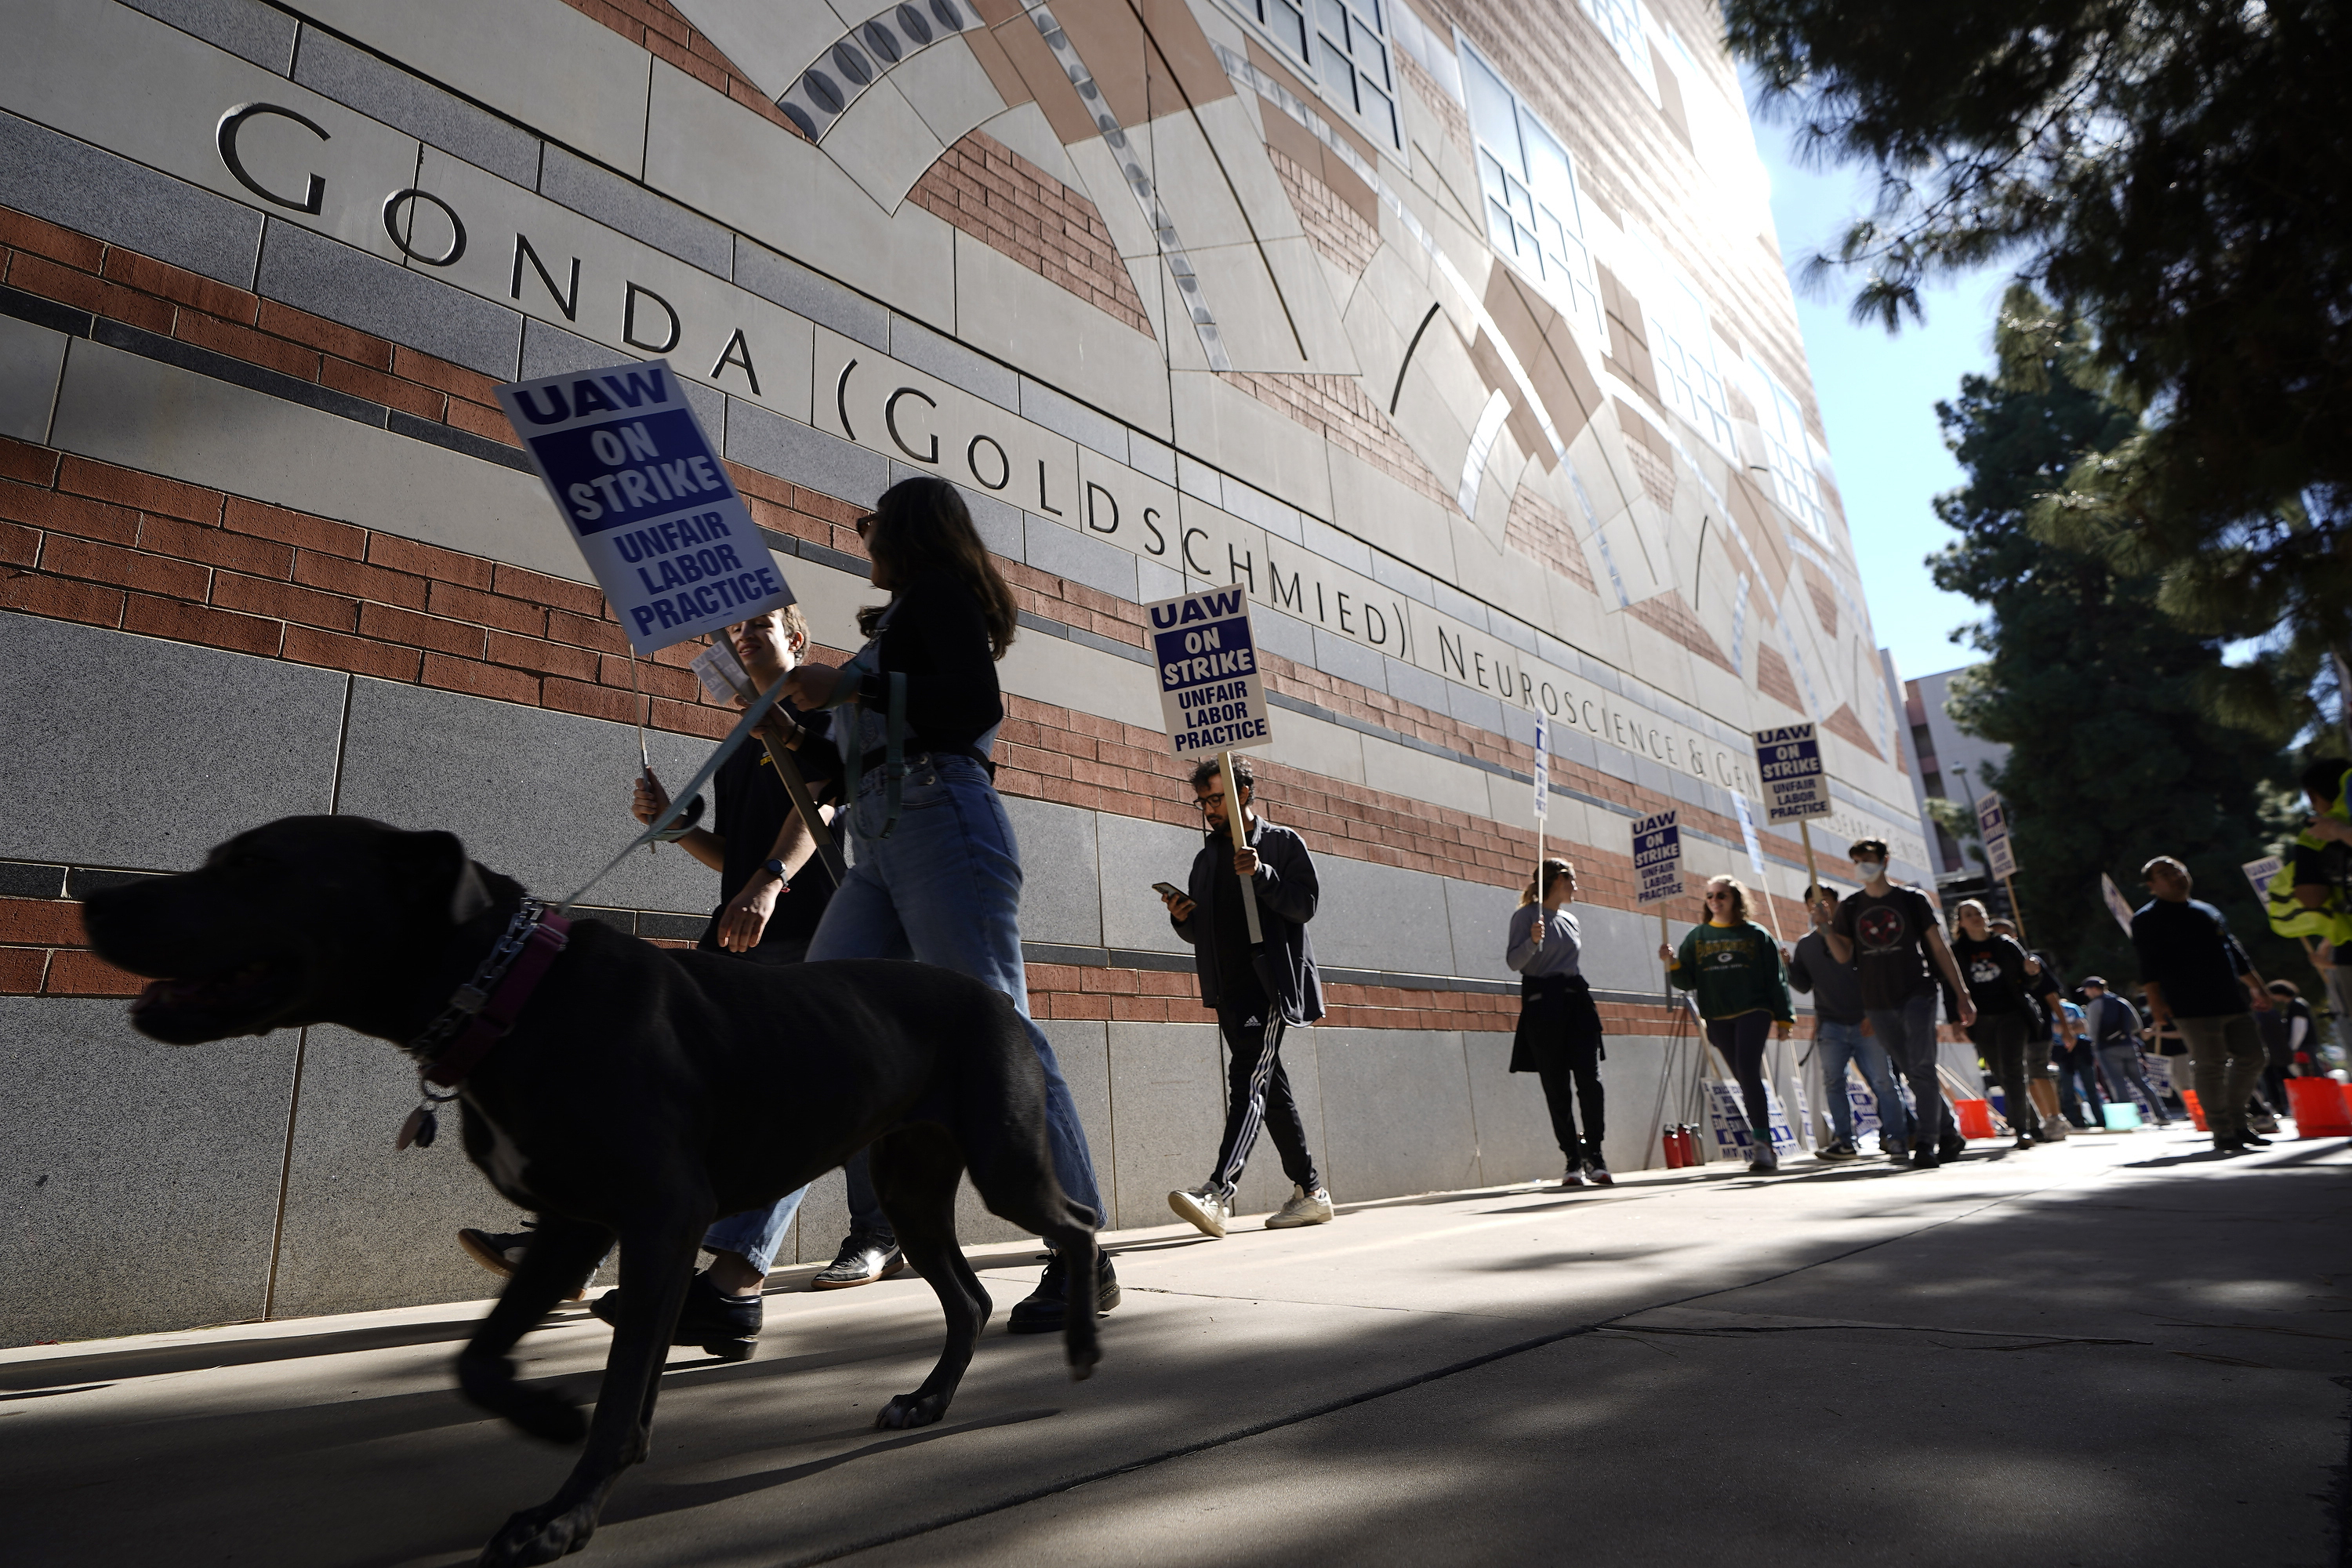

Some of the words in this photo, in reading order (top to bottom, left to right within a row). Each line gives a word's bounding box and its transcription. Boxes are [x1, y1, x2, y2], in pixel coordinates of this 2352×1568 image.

[511, 368, 668, 425] UAW
[216, 102, 761, 396] GONDA
[837, 358, 1405, 659] (GOLDSCHMIED)
[1438, 626, 1678, 765] NEUROSCIENCE
[1688, 739, 1708, 778] &
[590, 421, 659, 466] ON
[568, 455, 722, 521] STRIKE
[612, 511, 731, 563] UNFAIR
[637, 544, 743, 595] LABOR
[630, 568, 781, 637] PRACTICE
[1151, 590, 1242, 629] UAW
[1185, 627, 1221, 654] ON
[1164, 648, 1253, 685] STRIKE
[1178, 681, 1247, 709] UNFAIR
[1185, 702, 1248, 728] LABOR
[1174, 718, 1267, 752] PRACTICE
[1757, 724, 1812, 744] UAW
[1776, 744, 1800, 760] ON
[1762, 757, 1819, 779] STRIKE
[1773, 779, 1816, 793] UNFAIR
[1777, 790, 1816, 805] LABOR
[1770, 800, 1828, 818] PRACTICE
[1633, 810, 1675, 835] UAW
[1646, 832, 1664, 848] ON
[1635, 843, 1679, 866] STRIKE
[1641, 862, 1675, 878] UNFAIR
[1644, 873, 1674, 890] LABOR
[1639, 882, 1684, 902] PRACTICE
